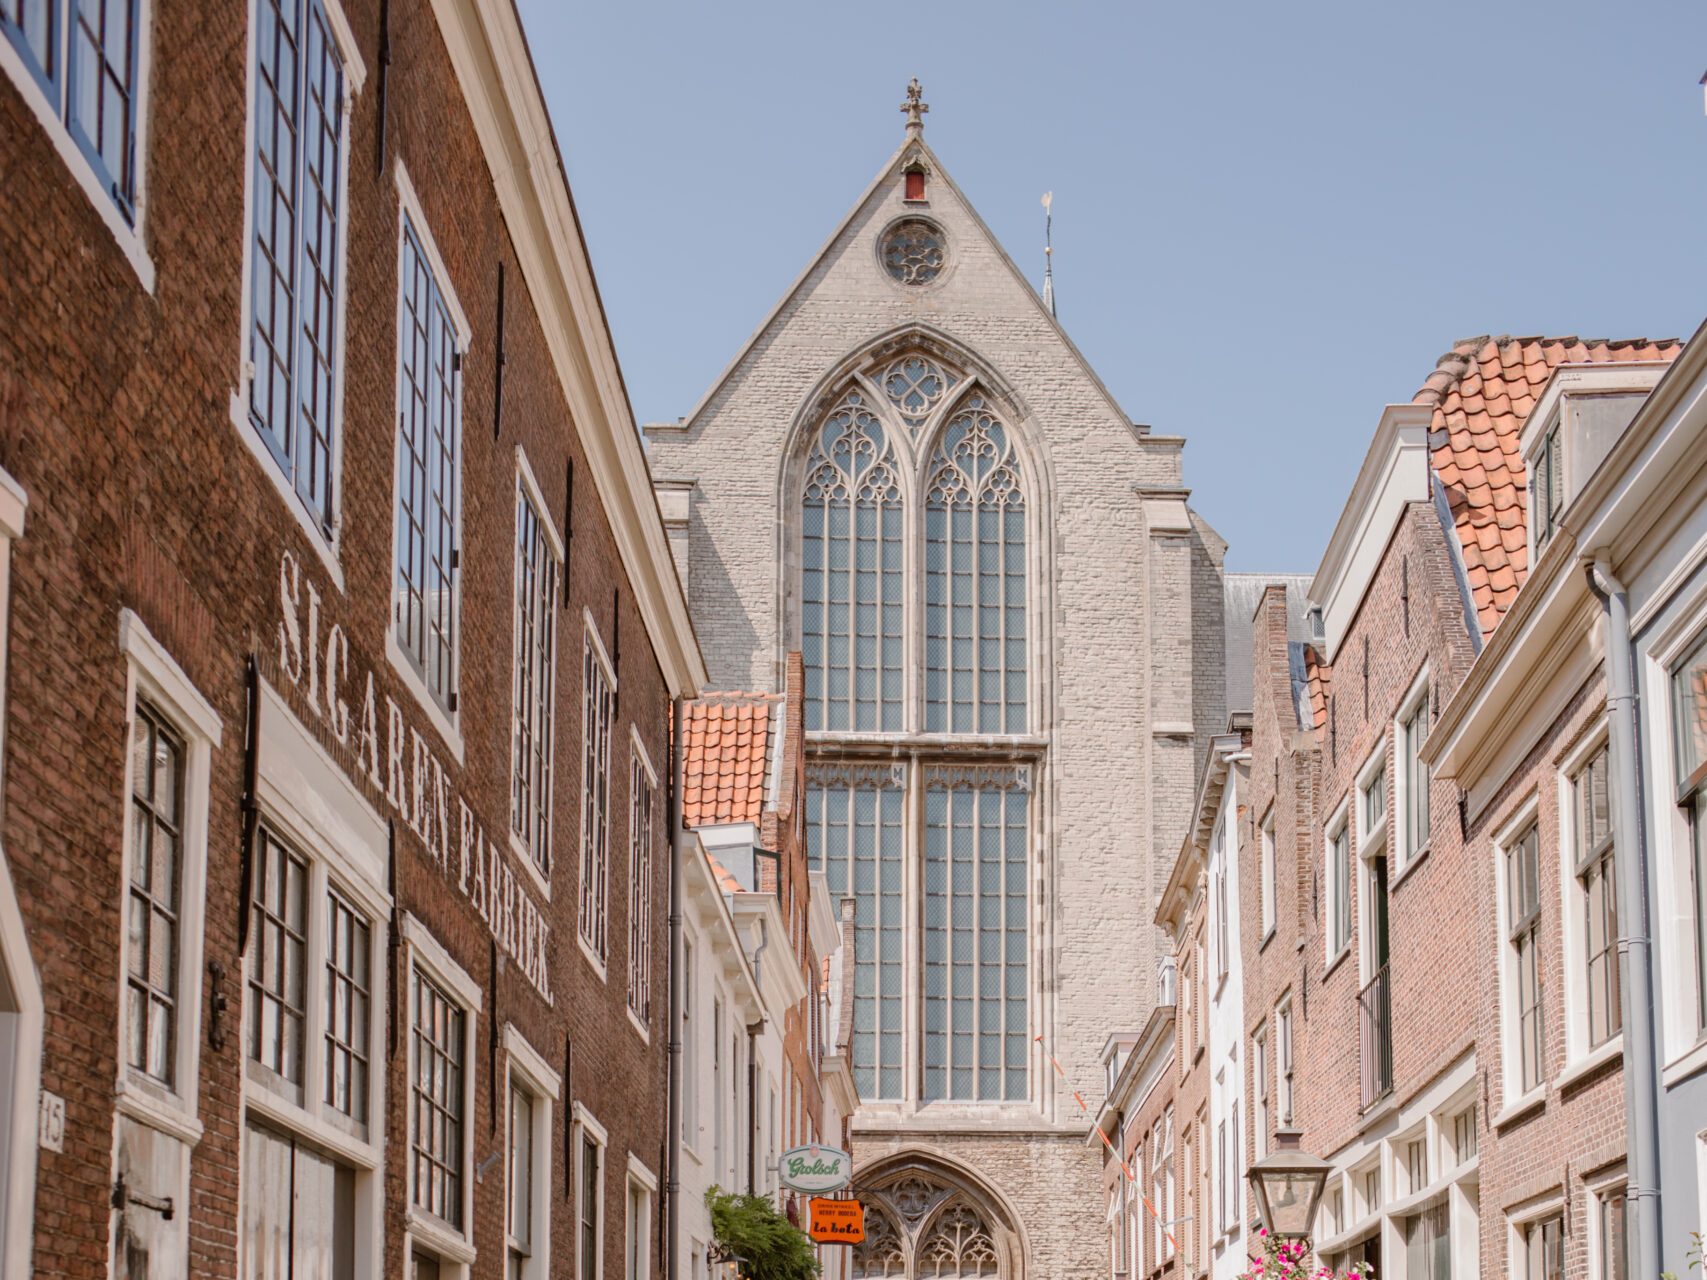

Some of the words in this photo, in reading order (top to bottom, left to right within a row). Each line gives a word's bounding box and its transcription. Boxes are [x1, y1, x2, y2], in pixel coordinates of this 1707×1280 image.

[277, 549, 452, 881] SIGAREN
[788, 1157, 841, 1178] Grolsch
[831, 1222, 860, 1233] bota
